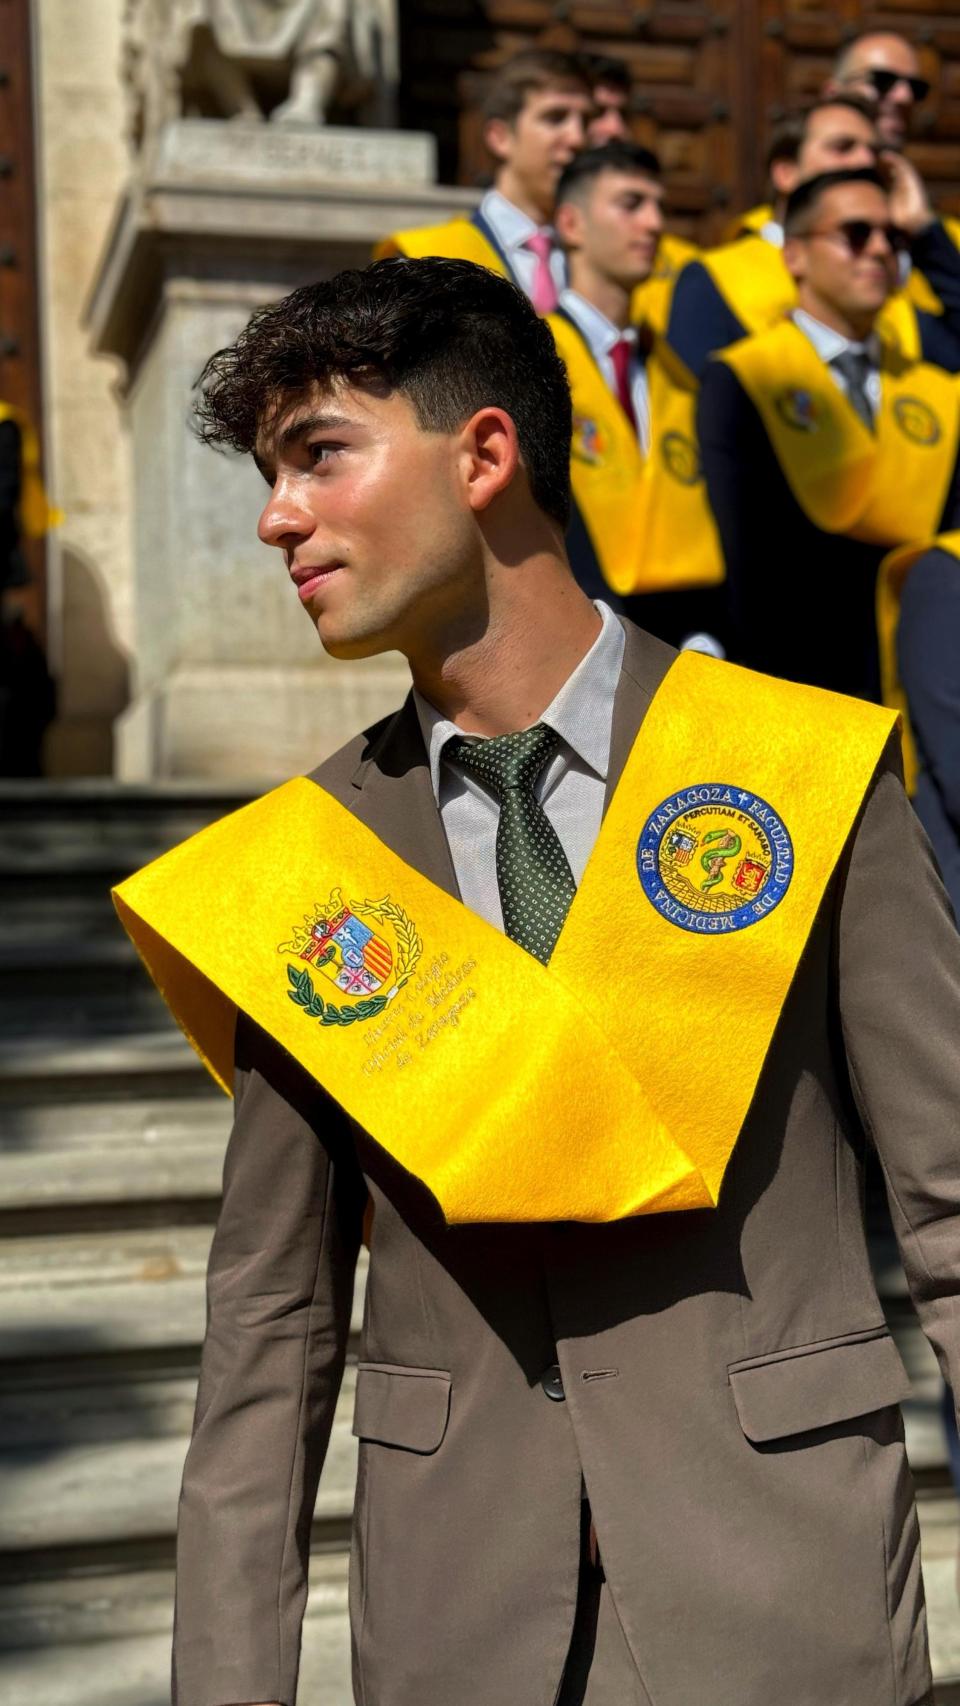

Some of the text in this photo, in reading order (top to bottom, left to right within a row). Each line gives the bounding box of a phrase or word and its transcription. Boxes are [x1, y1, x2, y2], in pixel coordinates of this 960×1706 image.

[641, 788, 790, 930] FACULTAD DE MEDICINA DE ZARAGOZA
[683, 807, 771, 857] PERCUTIAM ET SANABO
